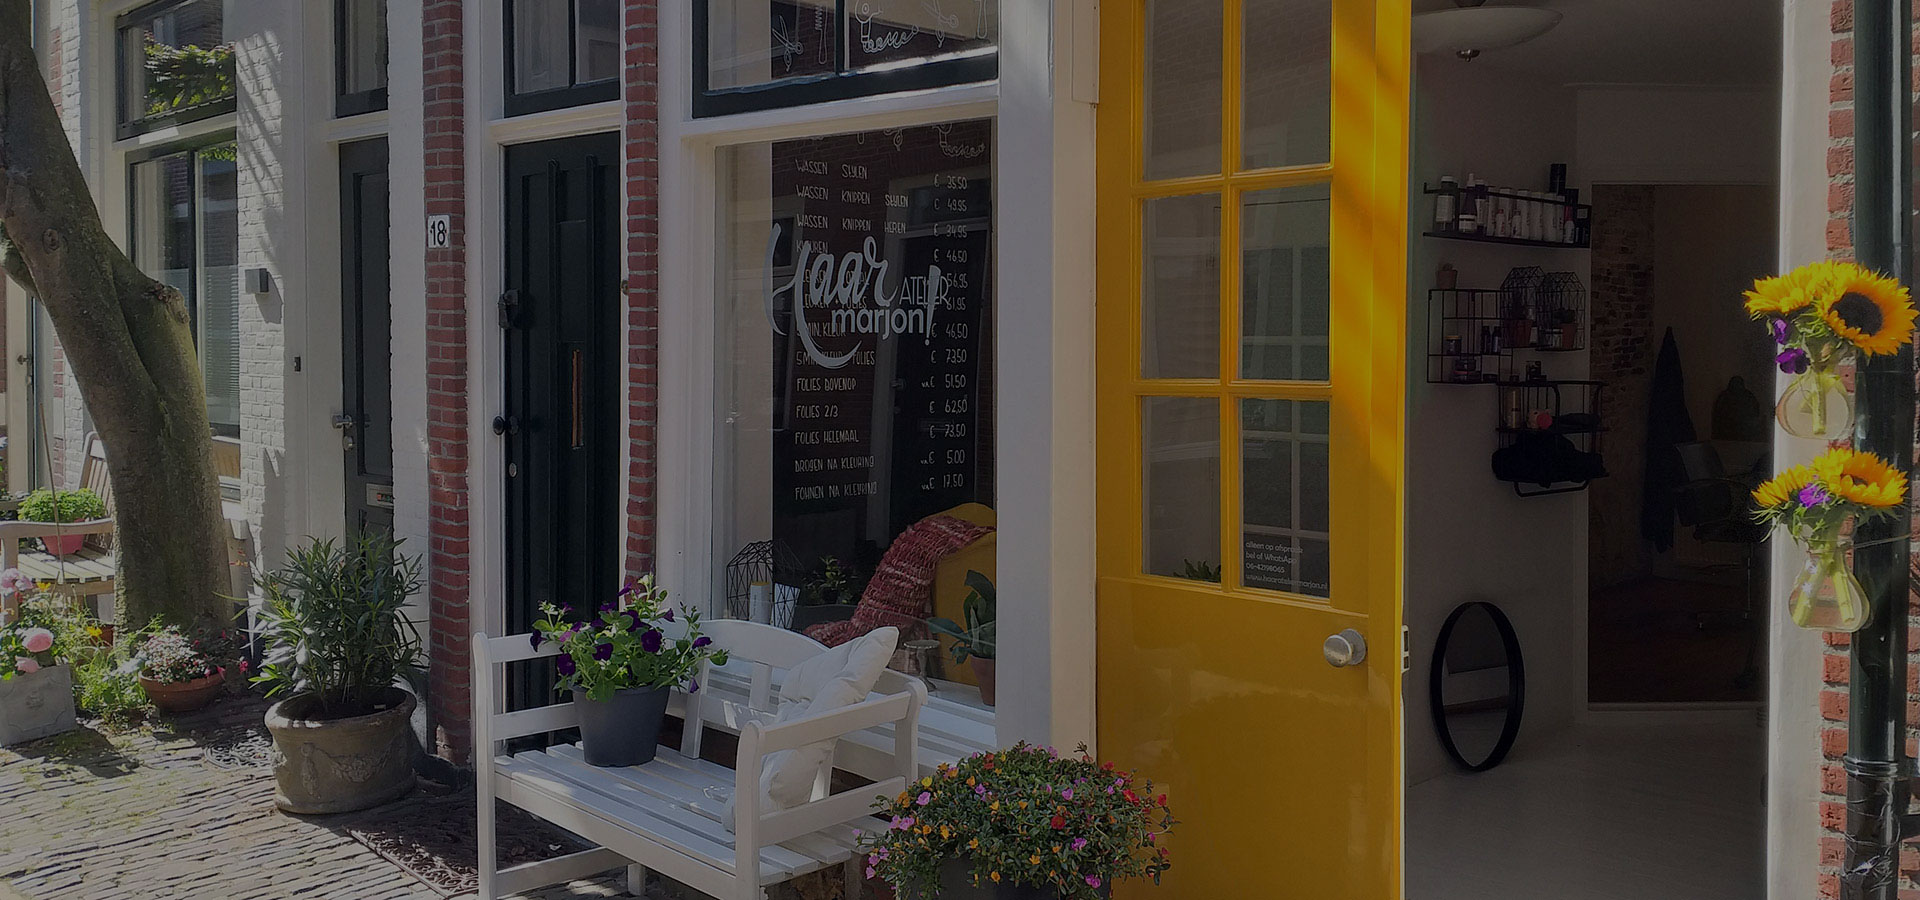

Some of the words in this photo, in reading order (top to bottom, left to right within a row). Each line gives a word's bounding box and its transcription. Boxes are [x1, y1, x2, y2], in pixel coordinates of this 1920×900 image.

[795, 159, 828, 175] WASSEN
[796, 184, 829, 201] WASSEN
[841, 190, 871, 205] KNIPPEN
[796, 213, 829, 230] WASSEN
[842, 218, 872, 232] KNIPPEN
[884, 221, 906, 234] HEREN
[431, 220, 445, 246] 18
[899, 274, 949, 305] ATELER
[795, 378, 821, 392] FOLIES
[824, 377, 857, 391] BOVENOP
[795, 405, 820, 419] FOLIES
[824, 404, 839, 418] 2/3
[795, 431, 820, 445] FOLIES
[823, 429, 860, 444] HELEMAAL
[795, 458, 823, 473] DROGEN
[827, 458, 838, 471] NA
[840, 455, 874, 470] KLEURING
[828, 484, 840, 498] NA
[843, 481, 878, 496] KLEURING
[1245, 541, 1264, 550] alleen
[1245, 551, 1256, 559] bel
[1256, 552, 1264, 560] of
[1264, 553, 1298, 565] WhatsApp
